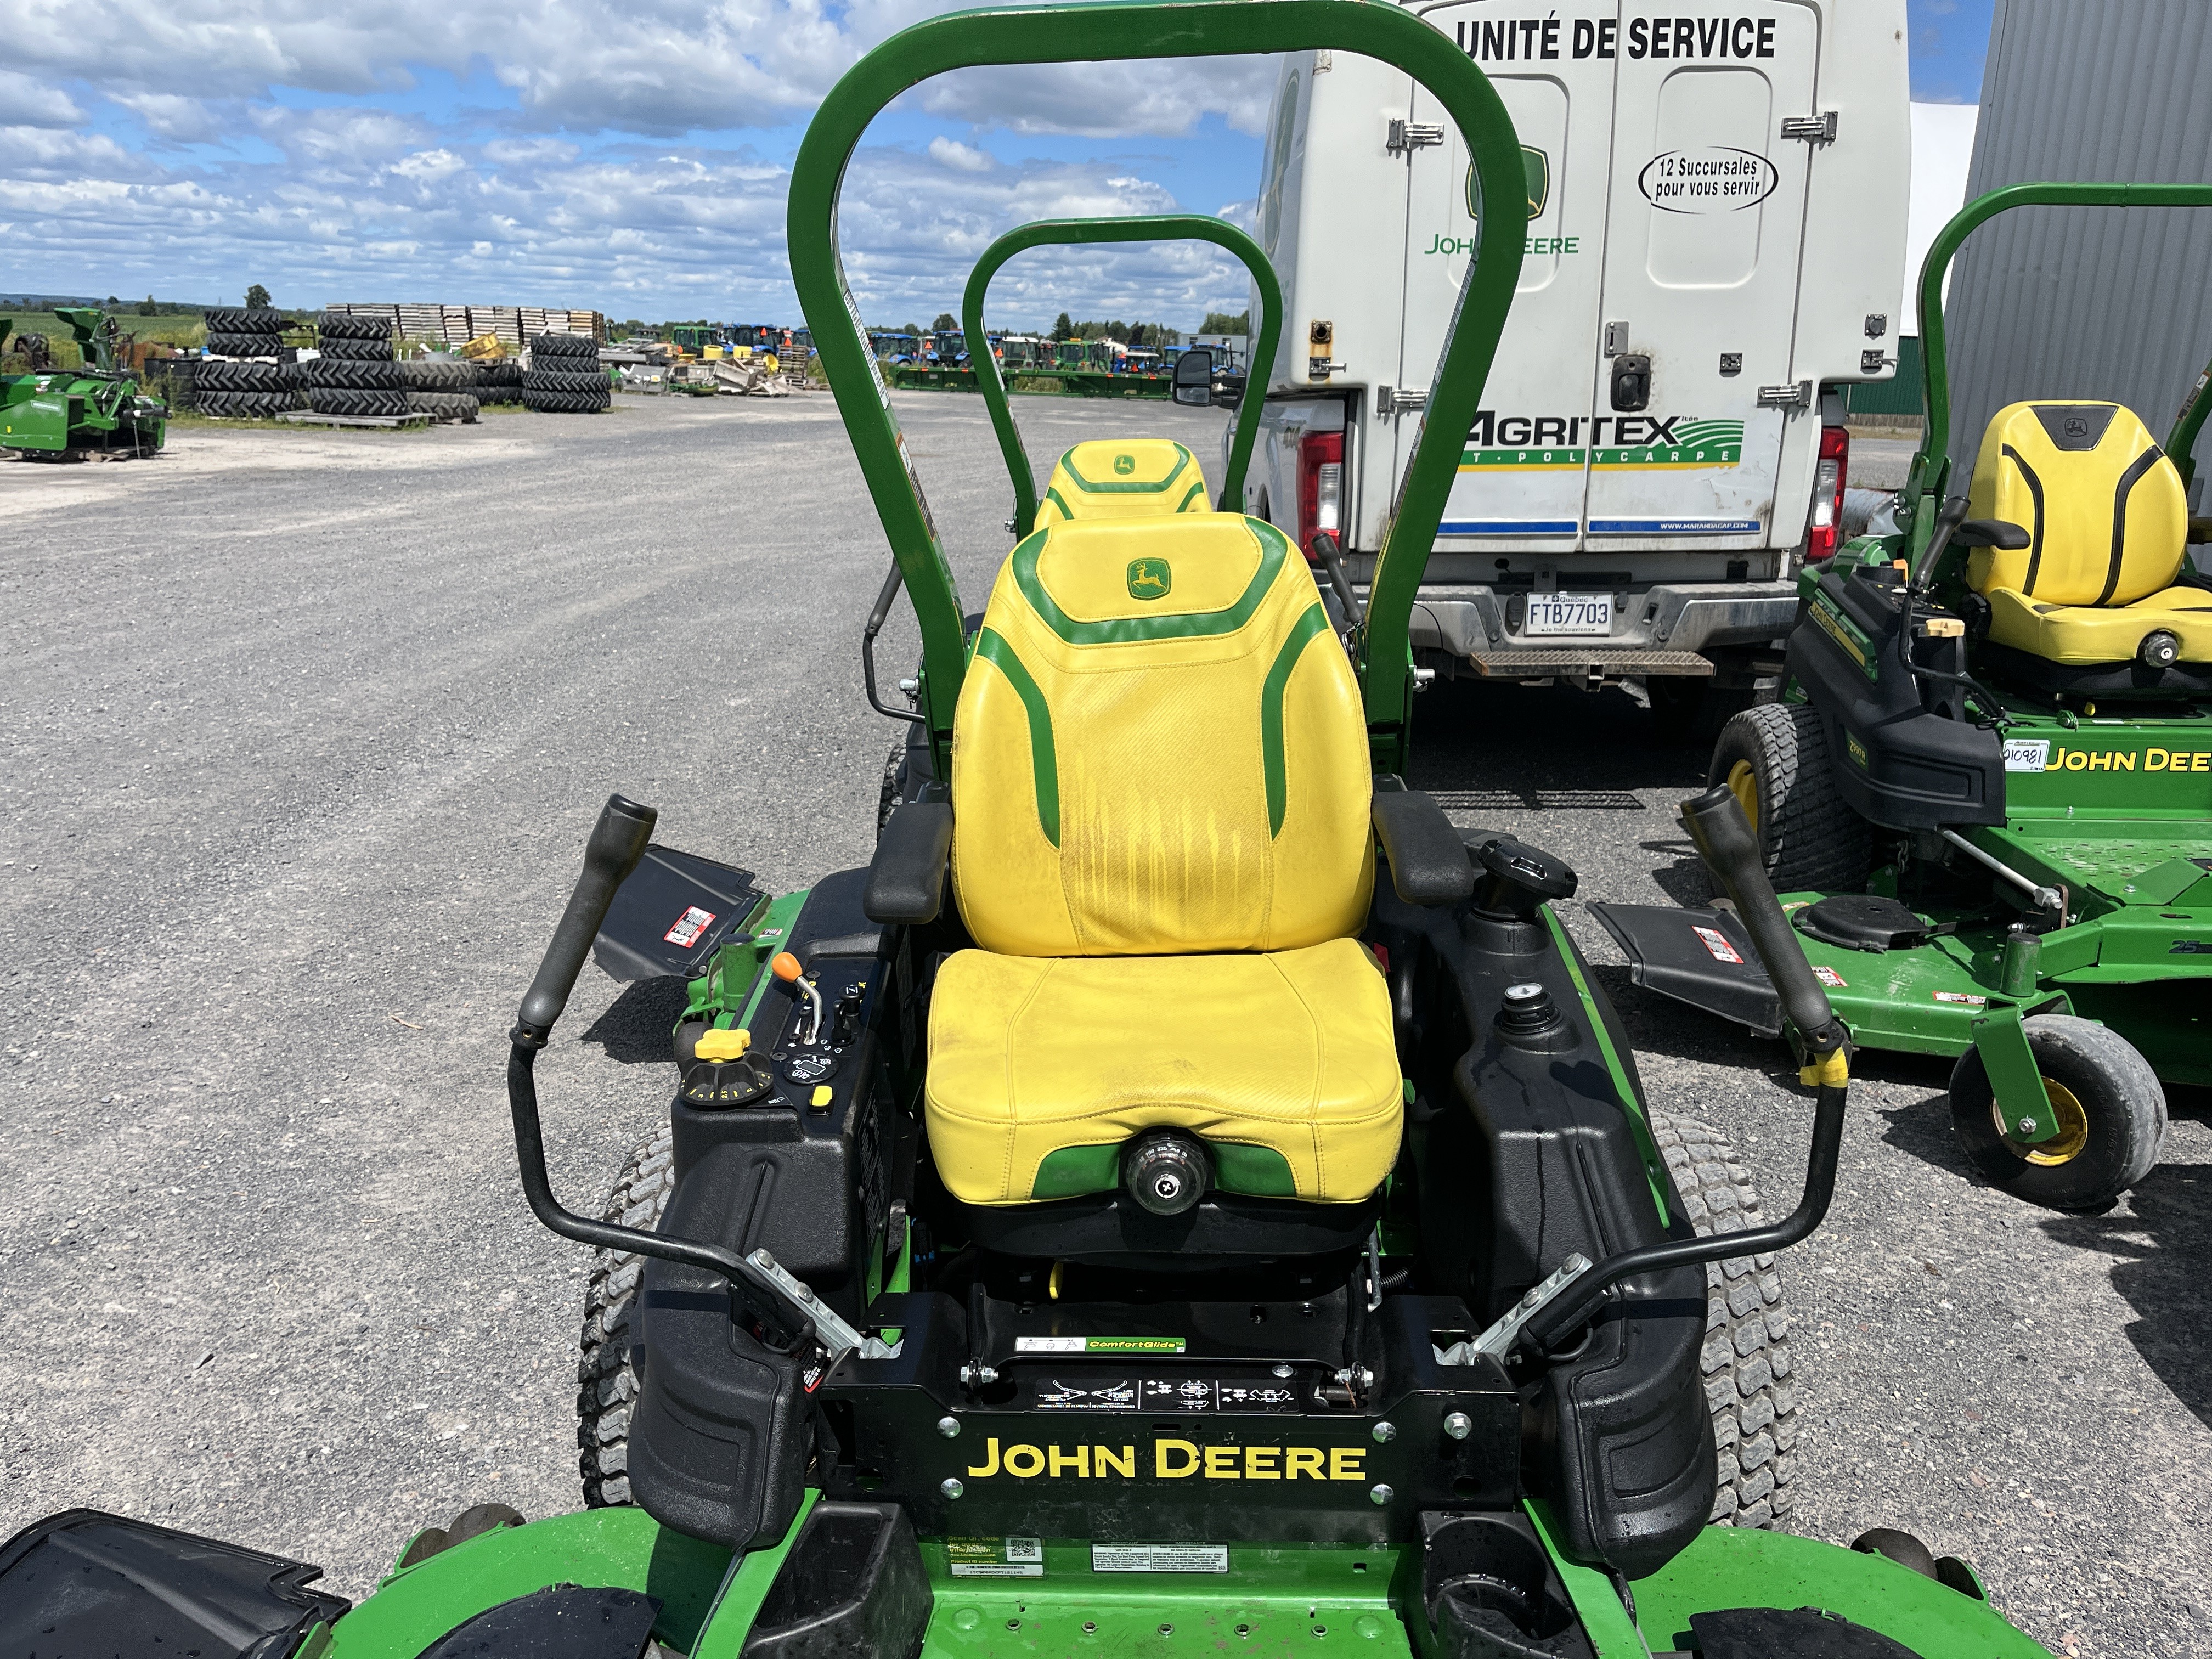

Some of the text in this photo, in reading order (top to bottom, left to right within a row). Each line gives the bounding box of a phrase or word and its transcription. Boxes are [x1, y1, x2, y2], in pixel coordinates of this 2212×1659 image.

[1457, 10, 1776, 60] UNITÉ DE SERVICE
[1660, 157, 1757, 176] 12 Succursales
[1656, 177, 1760, 201] pour vous servir
[1424, 234, 1579, 255] JOH EERE
[1466, 410, 1681, 447] AGRITEX
[1530, 603, 1608, 624] FTB7703
[2045, 747, 2212, 771] JOHN DEE
[968, 1437, 1367, 1480] JOHN DEERE
